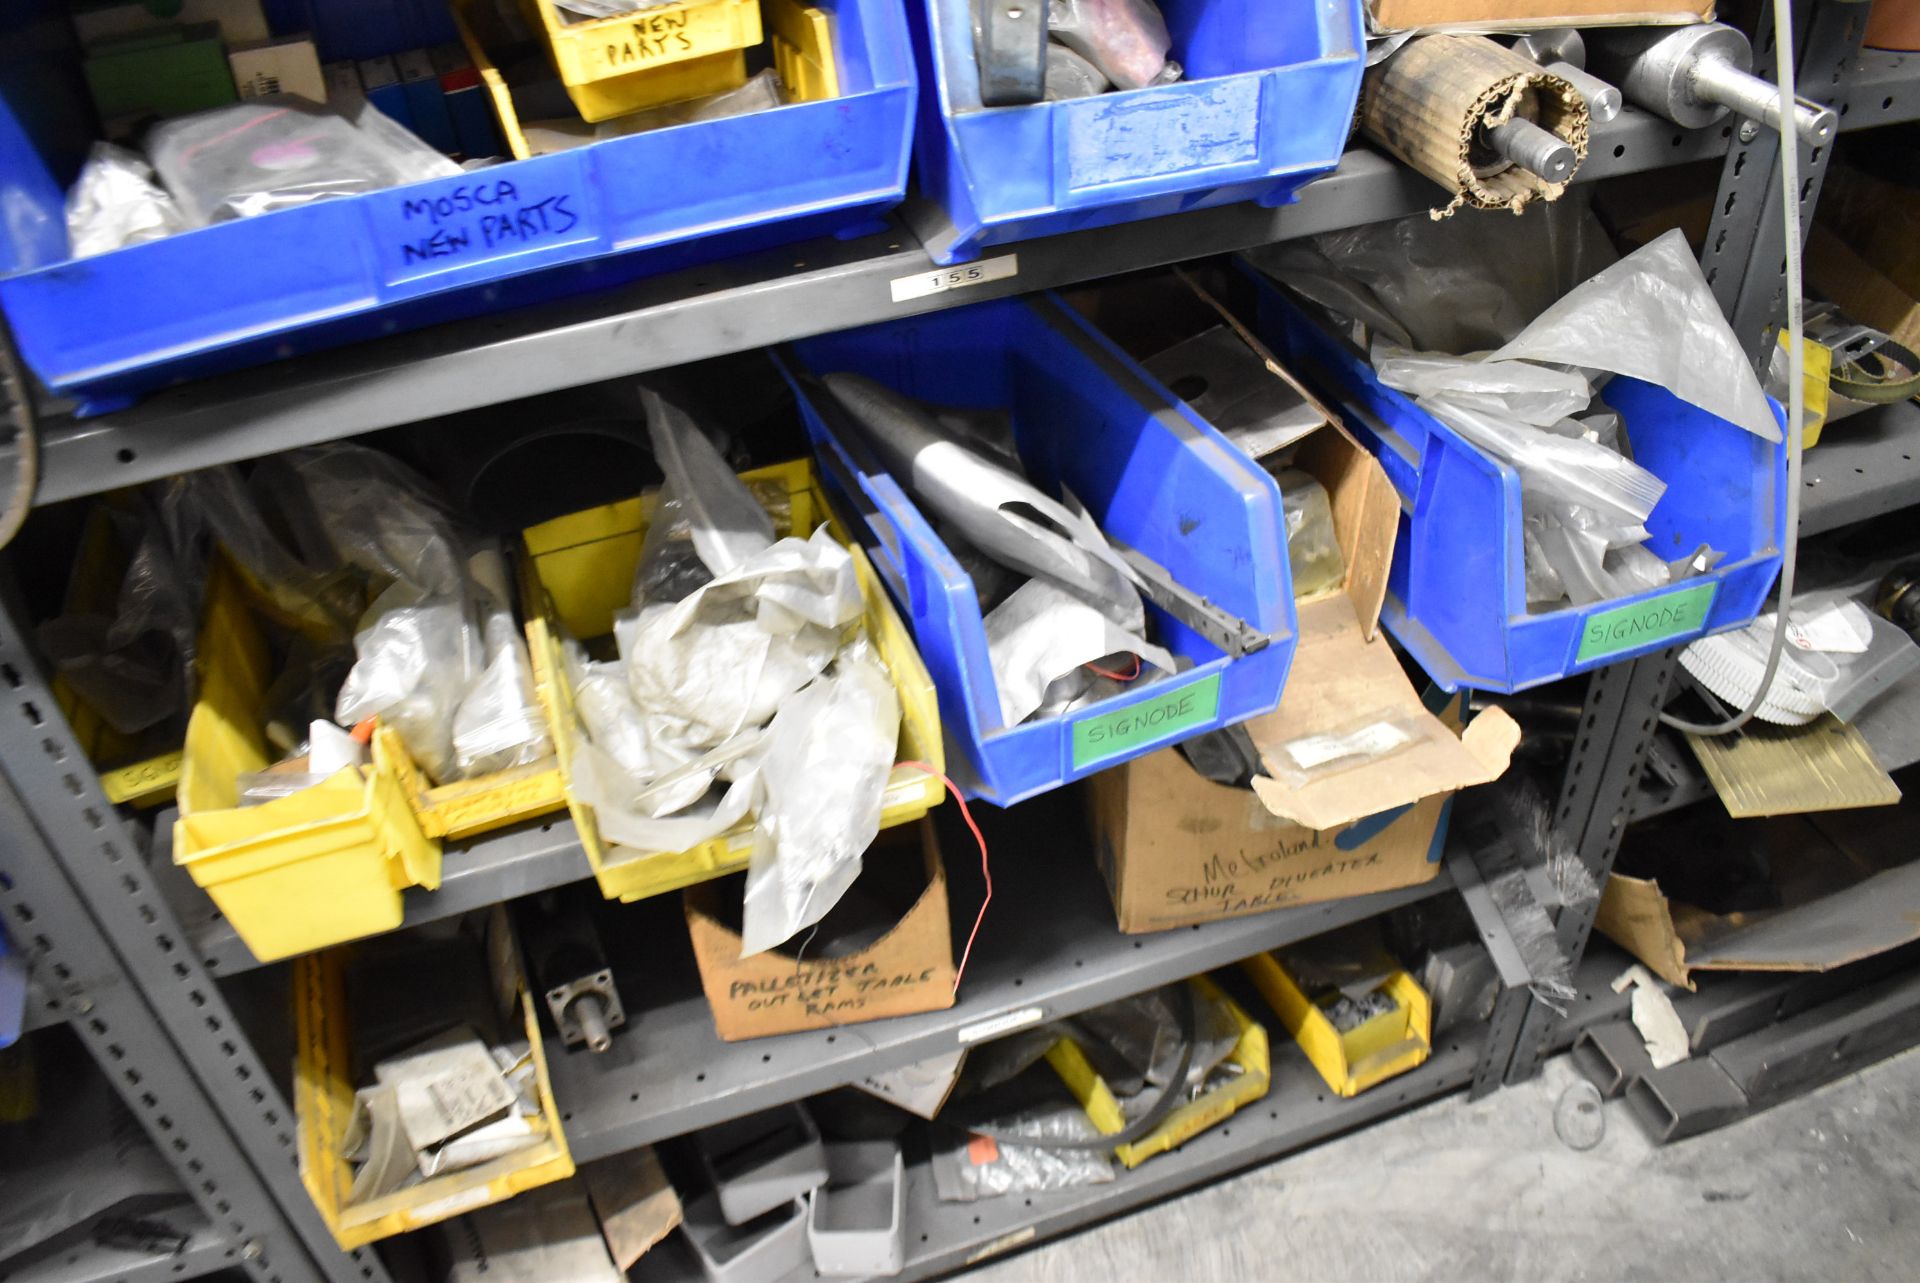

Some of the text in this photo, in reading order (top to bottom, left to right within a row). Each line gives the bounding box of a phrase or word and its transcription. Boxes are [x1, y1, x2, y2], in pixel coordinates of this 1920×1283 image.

[633, 9, 688, 37] NEW
[606, 31, 692, 66] PARTS
[403, 180, 518, 224] MOSCA
[402, 195, 578, 266] NEW PARTS
[1590, 602, 1688, 644] SIGNODE
[1087, 692, 1196, 744] SIGNODE
[857, 968, 936, 993] TABLE
[806, 998, 866, 1017] RAMS
